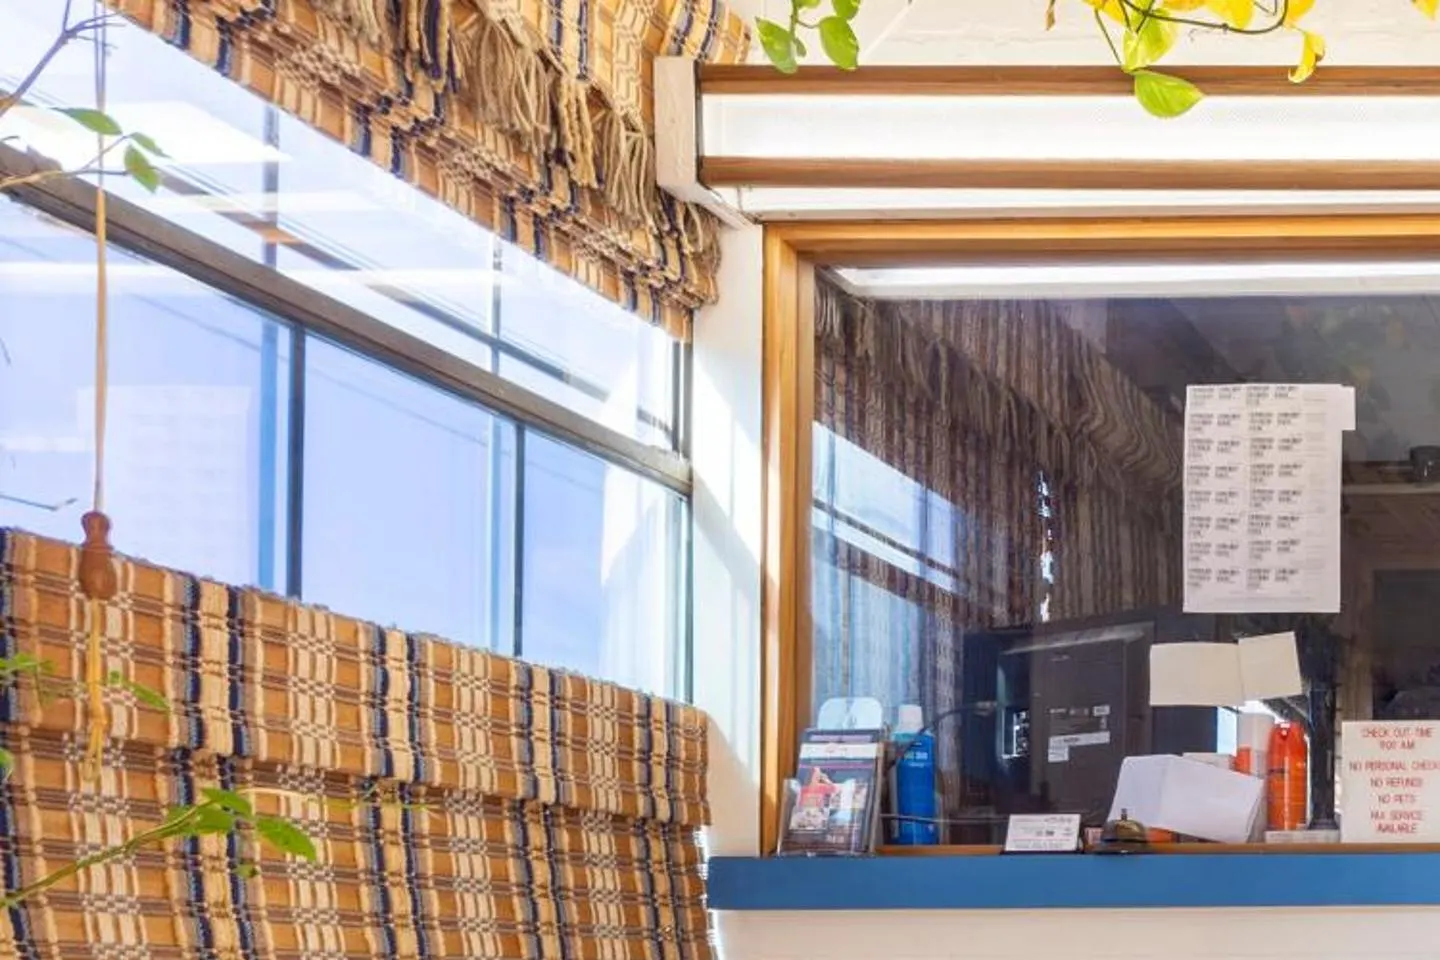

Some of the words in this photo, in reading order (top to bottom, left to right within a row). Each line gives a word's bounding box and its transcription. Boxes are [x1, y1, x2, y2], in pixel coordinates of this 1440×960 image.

[1362, 727, 1390, 738] CHECK
[1393, 727, 1410, 738] OUT
[1349, 761, 1362, 771] NO
[1365, 760, 1406, 771] PERSONAL
[1370, 778, 1383, 788] NO
[1378, 795, 1391, 804] NO
